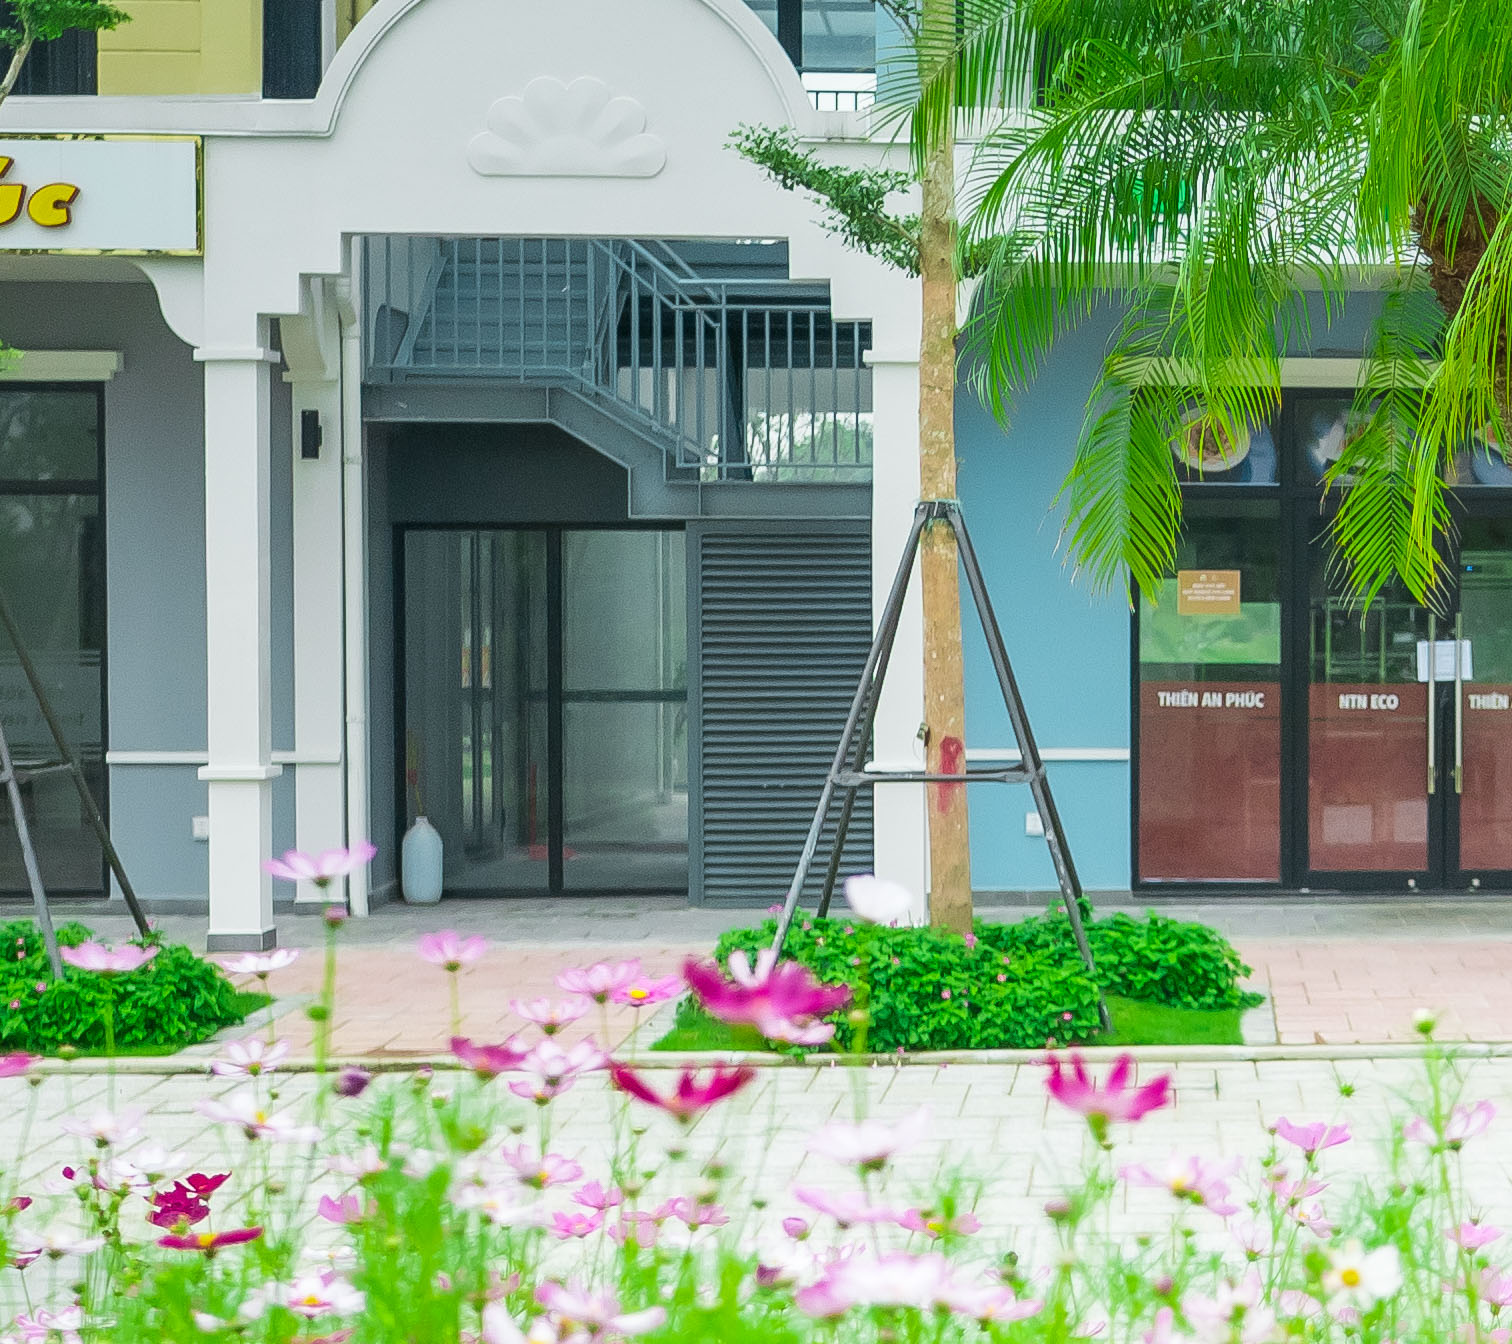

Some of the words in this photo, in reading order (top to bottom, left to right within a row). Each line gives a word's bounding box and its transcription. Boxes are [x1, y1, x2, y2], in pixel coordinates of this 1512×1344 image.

[1157, 688, 1199, 708] THIÊN
[1201, 692, 1223, 708] AN
[1225, 690, 1265, 709] PHÚC
[1338, 693, 1368, 711] NTN
[1370, 693, 1399, 711] ECO
[1468, 691, 1509, 710] THIÊN
